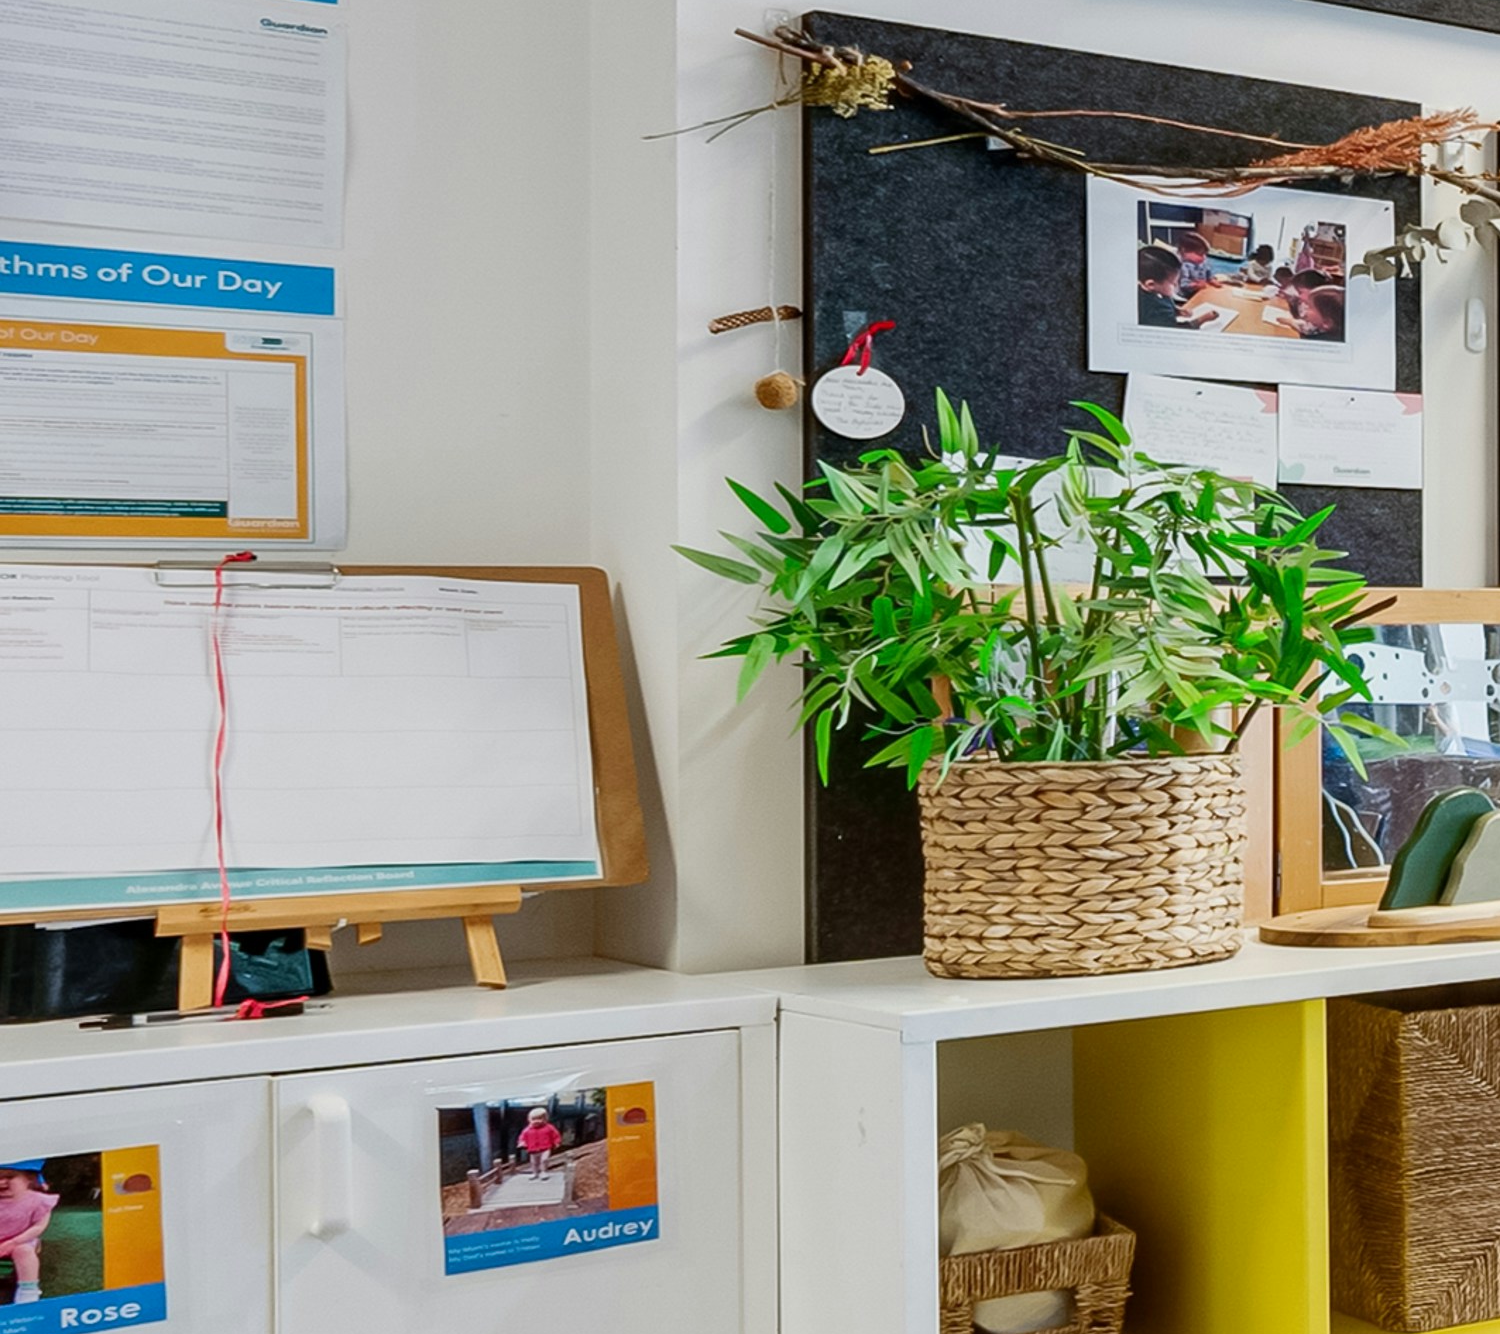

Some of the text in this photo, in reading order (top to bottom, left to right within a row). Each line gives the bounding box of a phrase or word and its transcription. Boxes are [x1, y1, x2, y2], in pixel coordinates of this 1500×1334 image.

[97, 263, 134, 283] of
[142, 264, 208, 289] Our
[217, 270, 284, 300] Day
[20, 328, 55, 343] Our
[60, 329, 99, 346] Day
[255, 875, 304, 888] Critical
[306, 872, 373, 885] Reflection
[376, 869, 415, 881] Board
[563, 1218, 654, 1246] Audrey
[60, 1301, 142, 1329] Rose
